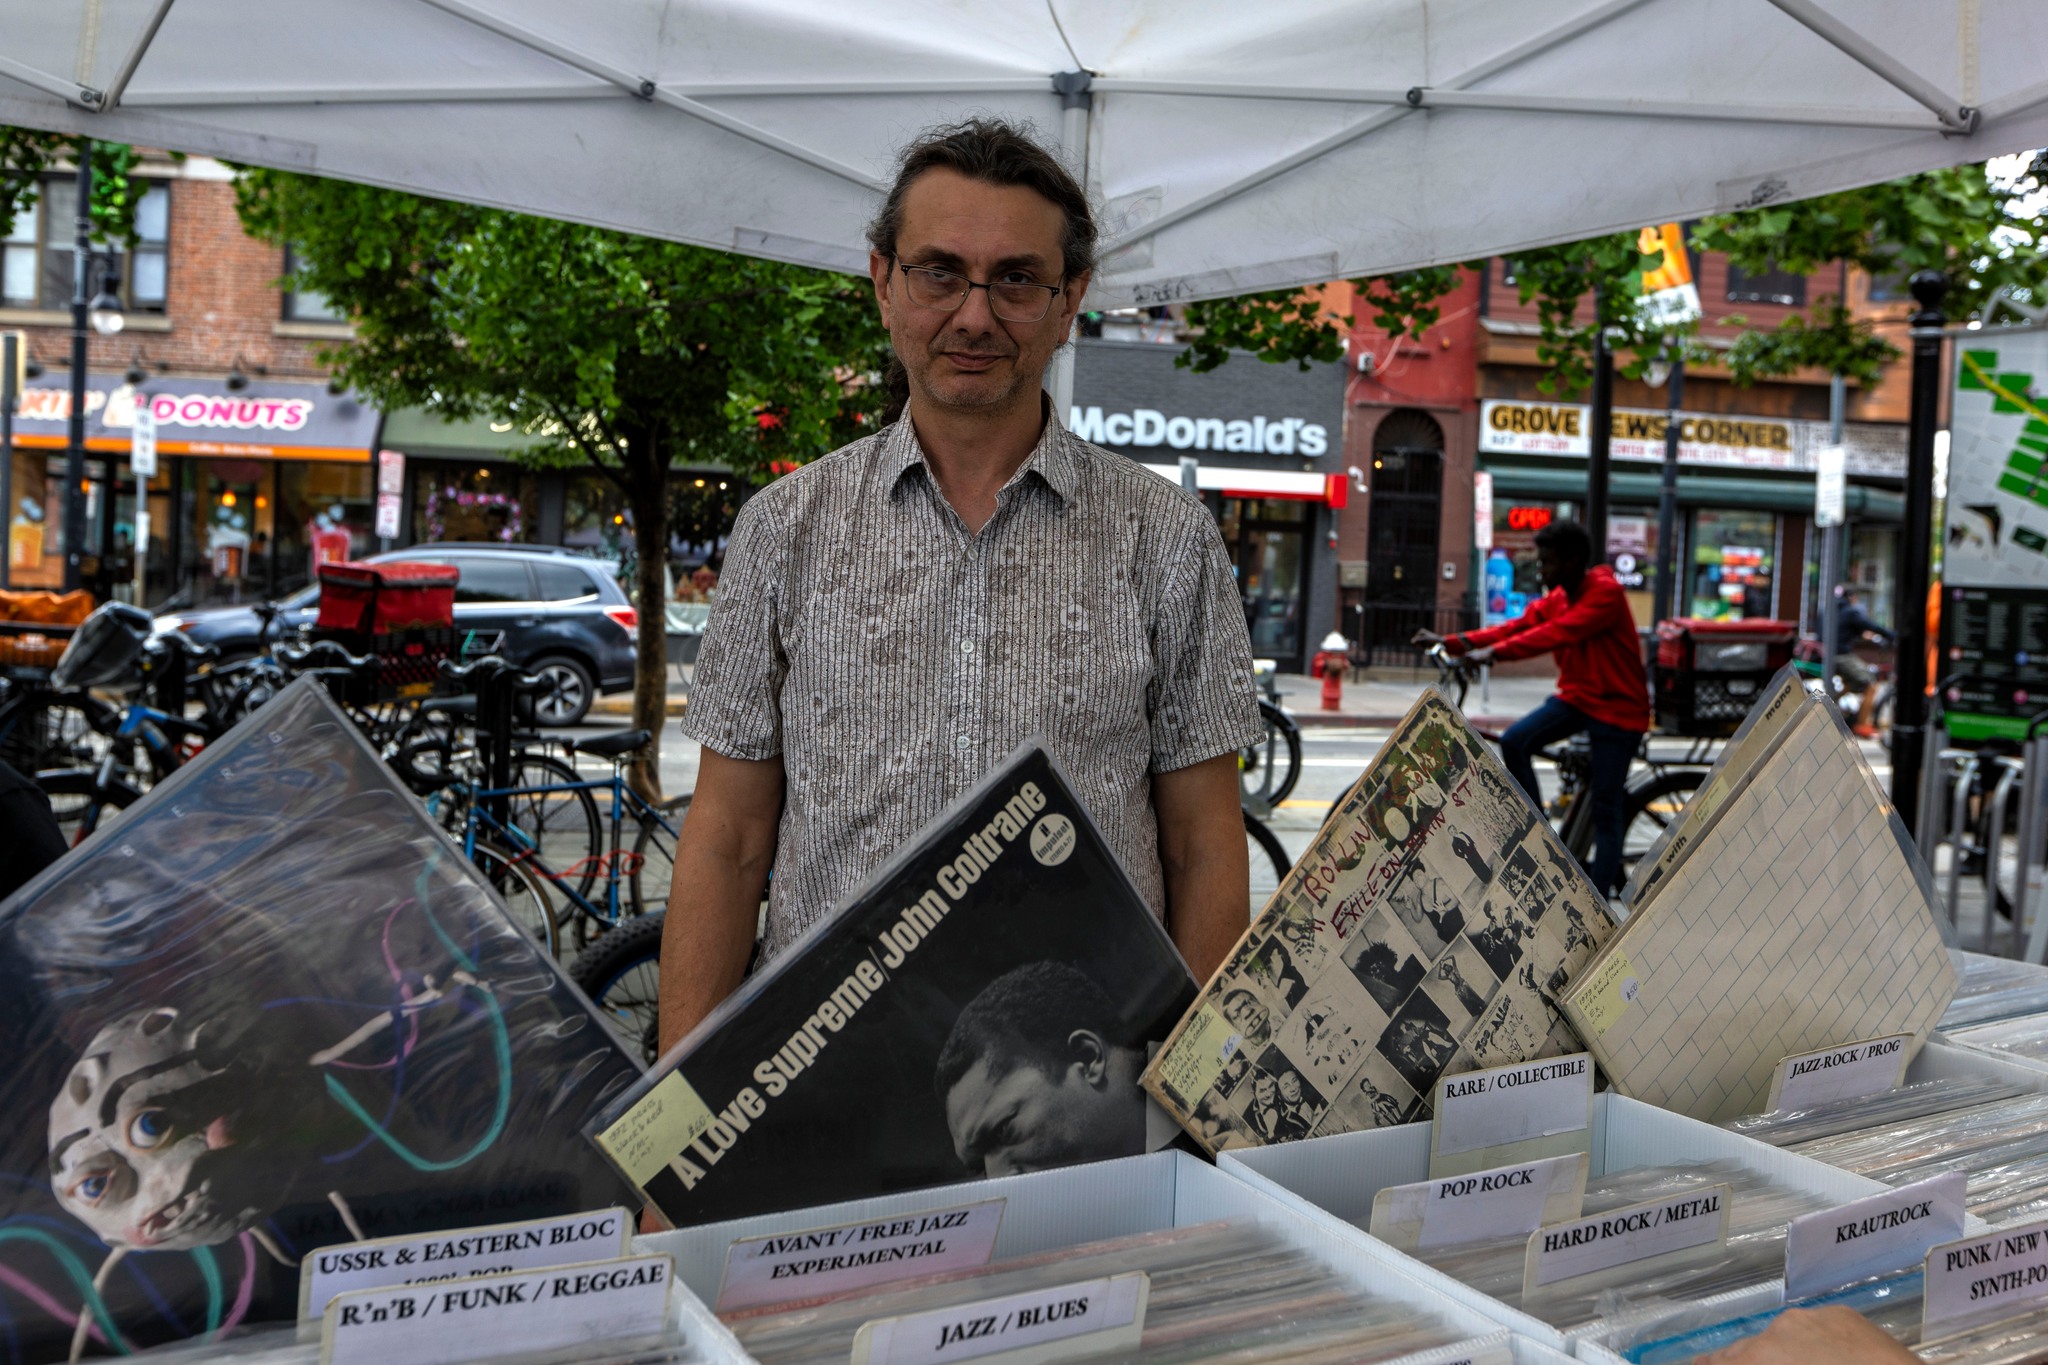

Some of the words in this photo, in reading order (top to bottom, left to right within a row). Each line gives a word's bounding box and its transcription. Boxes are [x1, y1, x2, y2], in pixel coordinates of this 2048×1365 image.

[152, 396, 306, 428] DONUTS
[1070, 405, 1328, 457] McDonald's
[1490, 405, 1581, 436] GROVE
[1590, 411, 1669, 441] EWS
[1680, 418, 1791, 450] CORNER
[1508, 507, 1551, 530] OPEN
[1765, 685, 1792, 720] mono
[1304, 819, 1373, 905] ROLLIN
[1380, 853, 1401, 880] ON
[1405, 809, 1446, 853] MAIN
[1665, 834, 1688, 864] with
[668, 1154, 707, 1191] A
[689, 1089, 766, 1167] Love
[936, 780, 1047, 900] Coltrane
[1445, 1078, 1487, 1099] RARE
[1488, 1077, 1495, 1092] /
[1497, 1059, 1586, 1090] COLLECTIBLE
[1790, 1048, 1859, 1080] JAZZ-ROCK
[1860, 1046, 1867, 1061] /
[1867, 1039, 1902, 1061] PROG
[1439, 1178, 1478, 1200] POP
[1480, 1168, 1537, 1194] ROCK
[759, 1229, 842, 1258] AVANT
[843, 1226, 856, 1246] /
[859, 1219, 916, 1242] FREE
[915, 1210, 970, 1236] JAZZ
[1543, 1228, 1599, 1254] HARD
[1600, 1211, 1652, 1240] ROCK
[1654, 1209, 1664, 1228] /
[1664, 1195, 1722, 1225] METAL
[1835, 1200, 1934, 1245] KRAUTROCK
[318, 1249, 389, 1276] USSR
[393, 1246, 418, 1266] &
[422, 1228, 545, 1262] EASTERN
[549, 1217, 616, 1245] BLOC
[769, 1238, 946, 1281] EXPERIMENTAL
[1945, 1242, 1993, 1272] PUNK
[1994, 1240, 2003, 1262] /
[2004, 1230, 2042, 1258] NEW
[338, 1297, 416, 1328] R'n'B
[421, 1294, 437, 1319] /
[443, 1281, 528, 1315] FUNK
[531, 1280, 547, 1303] /
[550, 1263, 664, 1298] REGGAE
[1969, 1263, 2048, 1301] SYNTH-PO
[936, 1318, 998, 1350] JAZZ
[1000, 1313, 1013, 1334] /
[1016, 1296, 1089, 1329] BLUES
